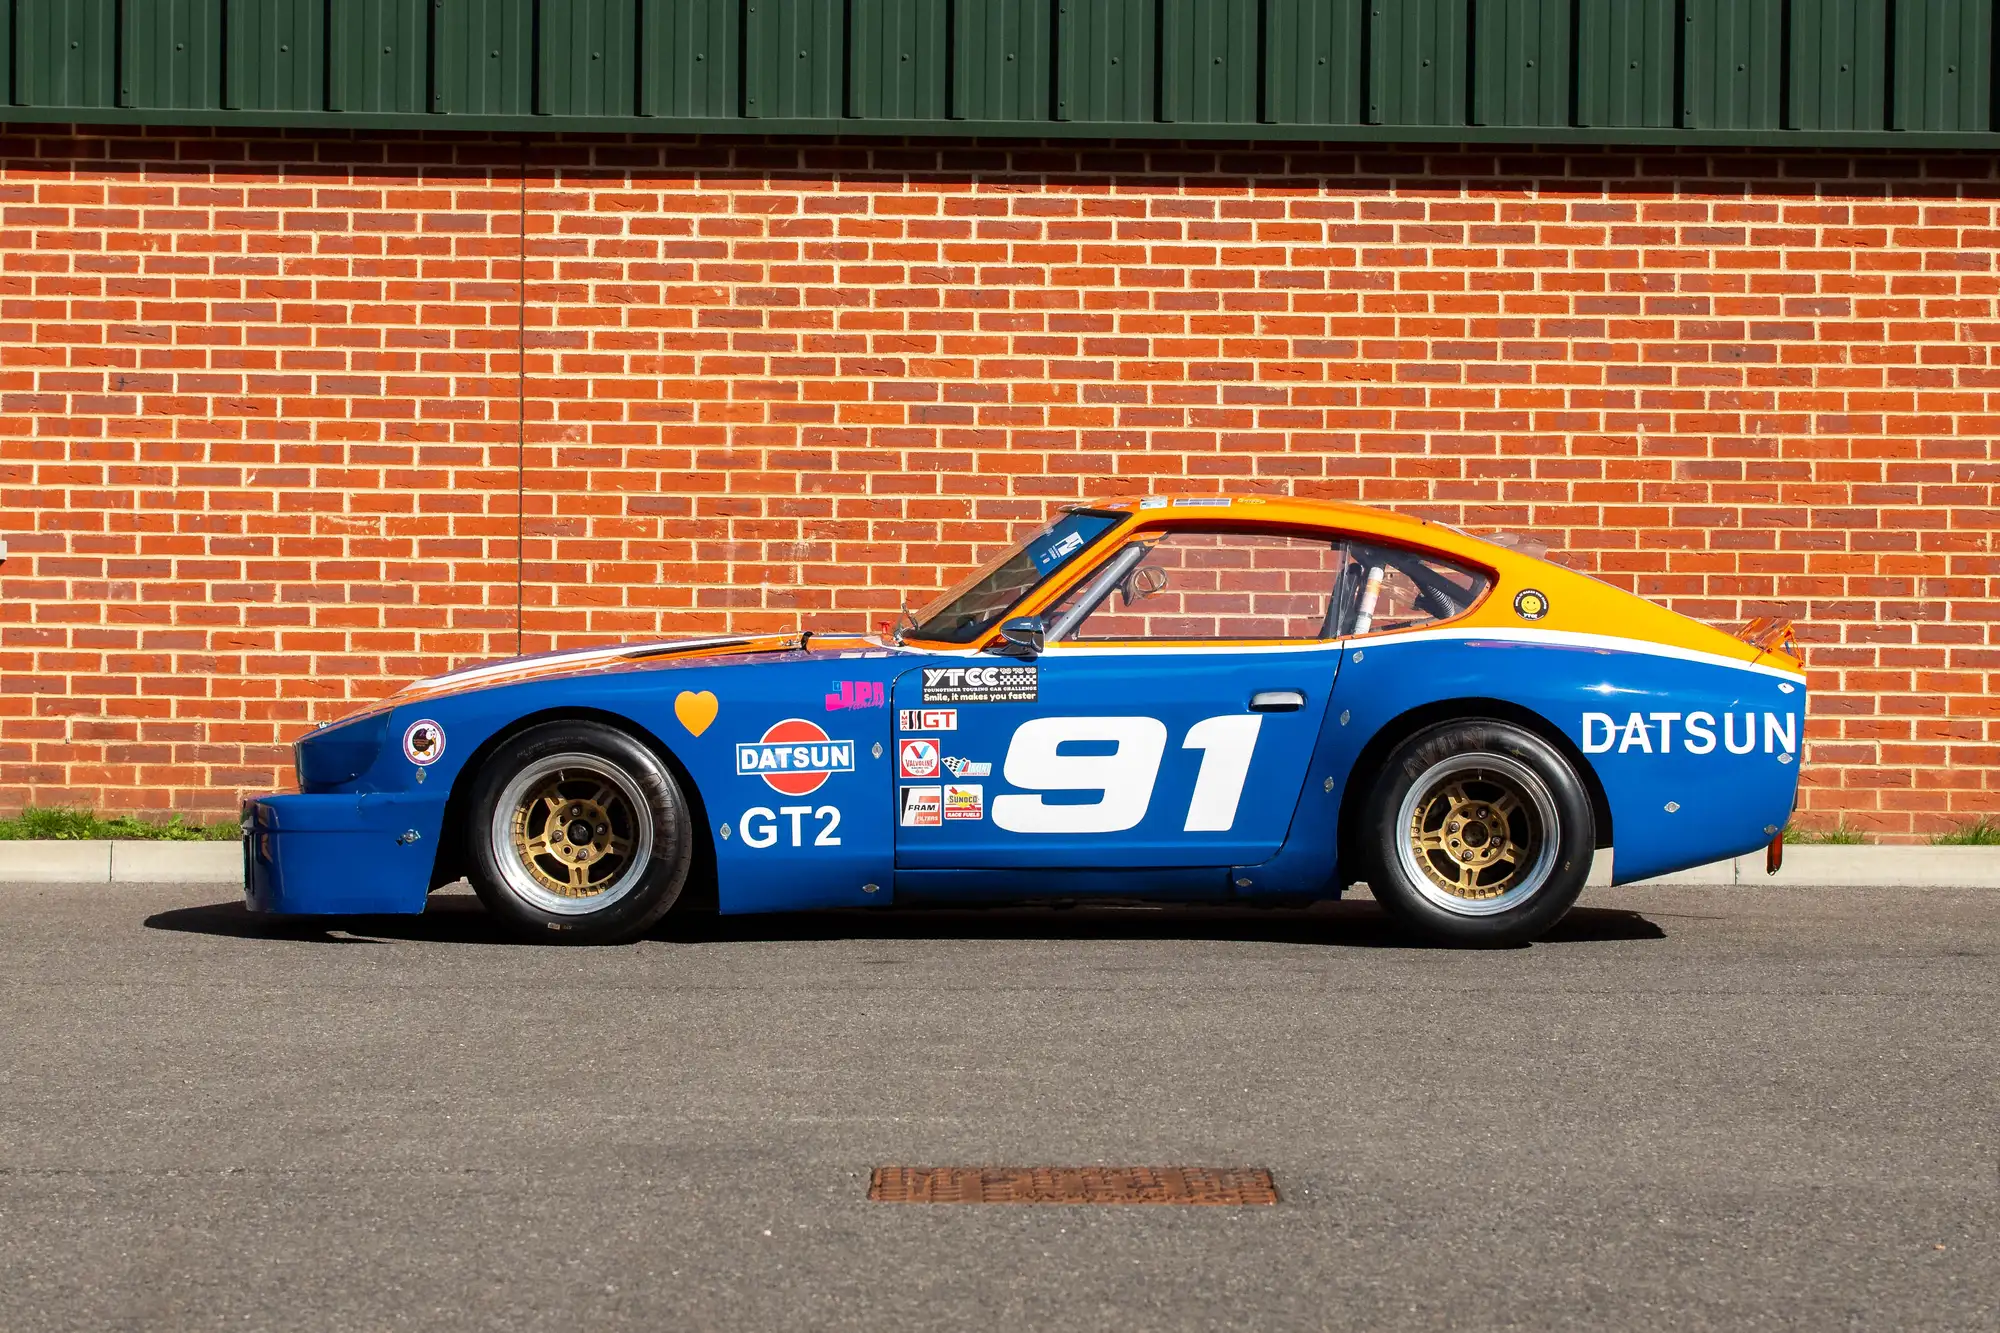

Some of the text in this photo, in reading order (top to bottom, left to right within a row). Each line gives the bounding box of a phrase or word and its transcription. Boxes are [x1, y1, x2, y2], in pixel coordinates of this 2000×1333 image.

[923, 667, 999, 687] YTCC
[924, 691, 1036, 702] Smile, it makes you faster
[923, 711, 956, 728] GT
[1582, 711, 1796, 755] DATSUN
[741, 745, 850, 770] DATSUN
[905, 758, 934, 768] VALVOLINE
[991, 714, 1264, 834] 91
[949, 795, 978, 803] SUNOCO
[739, 805, 842, 849] GT2
